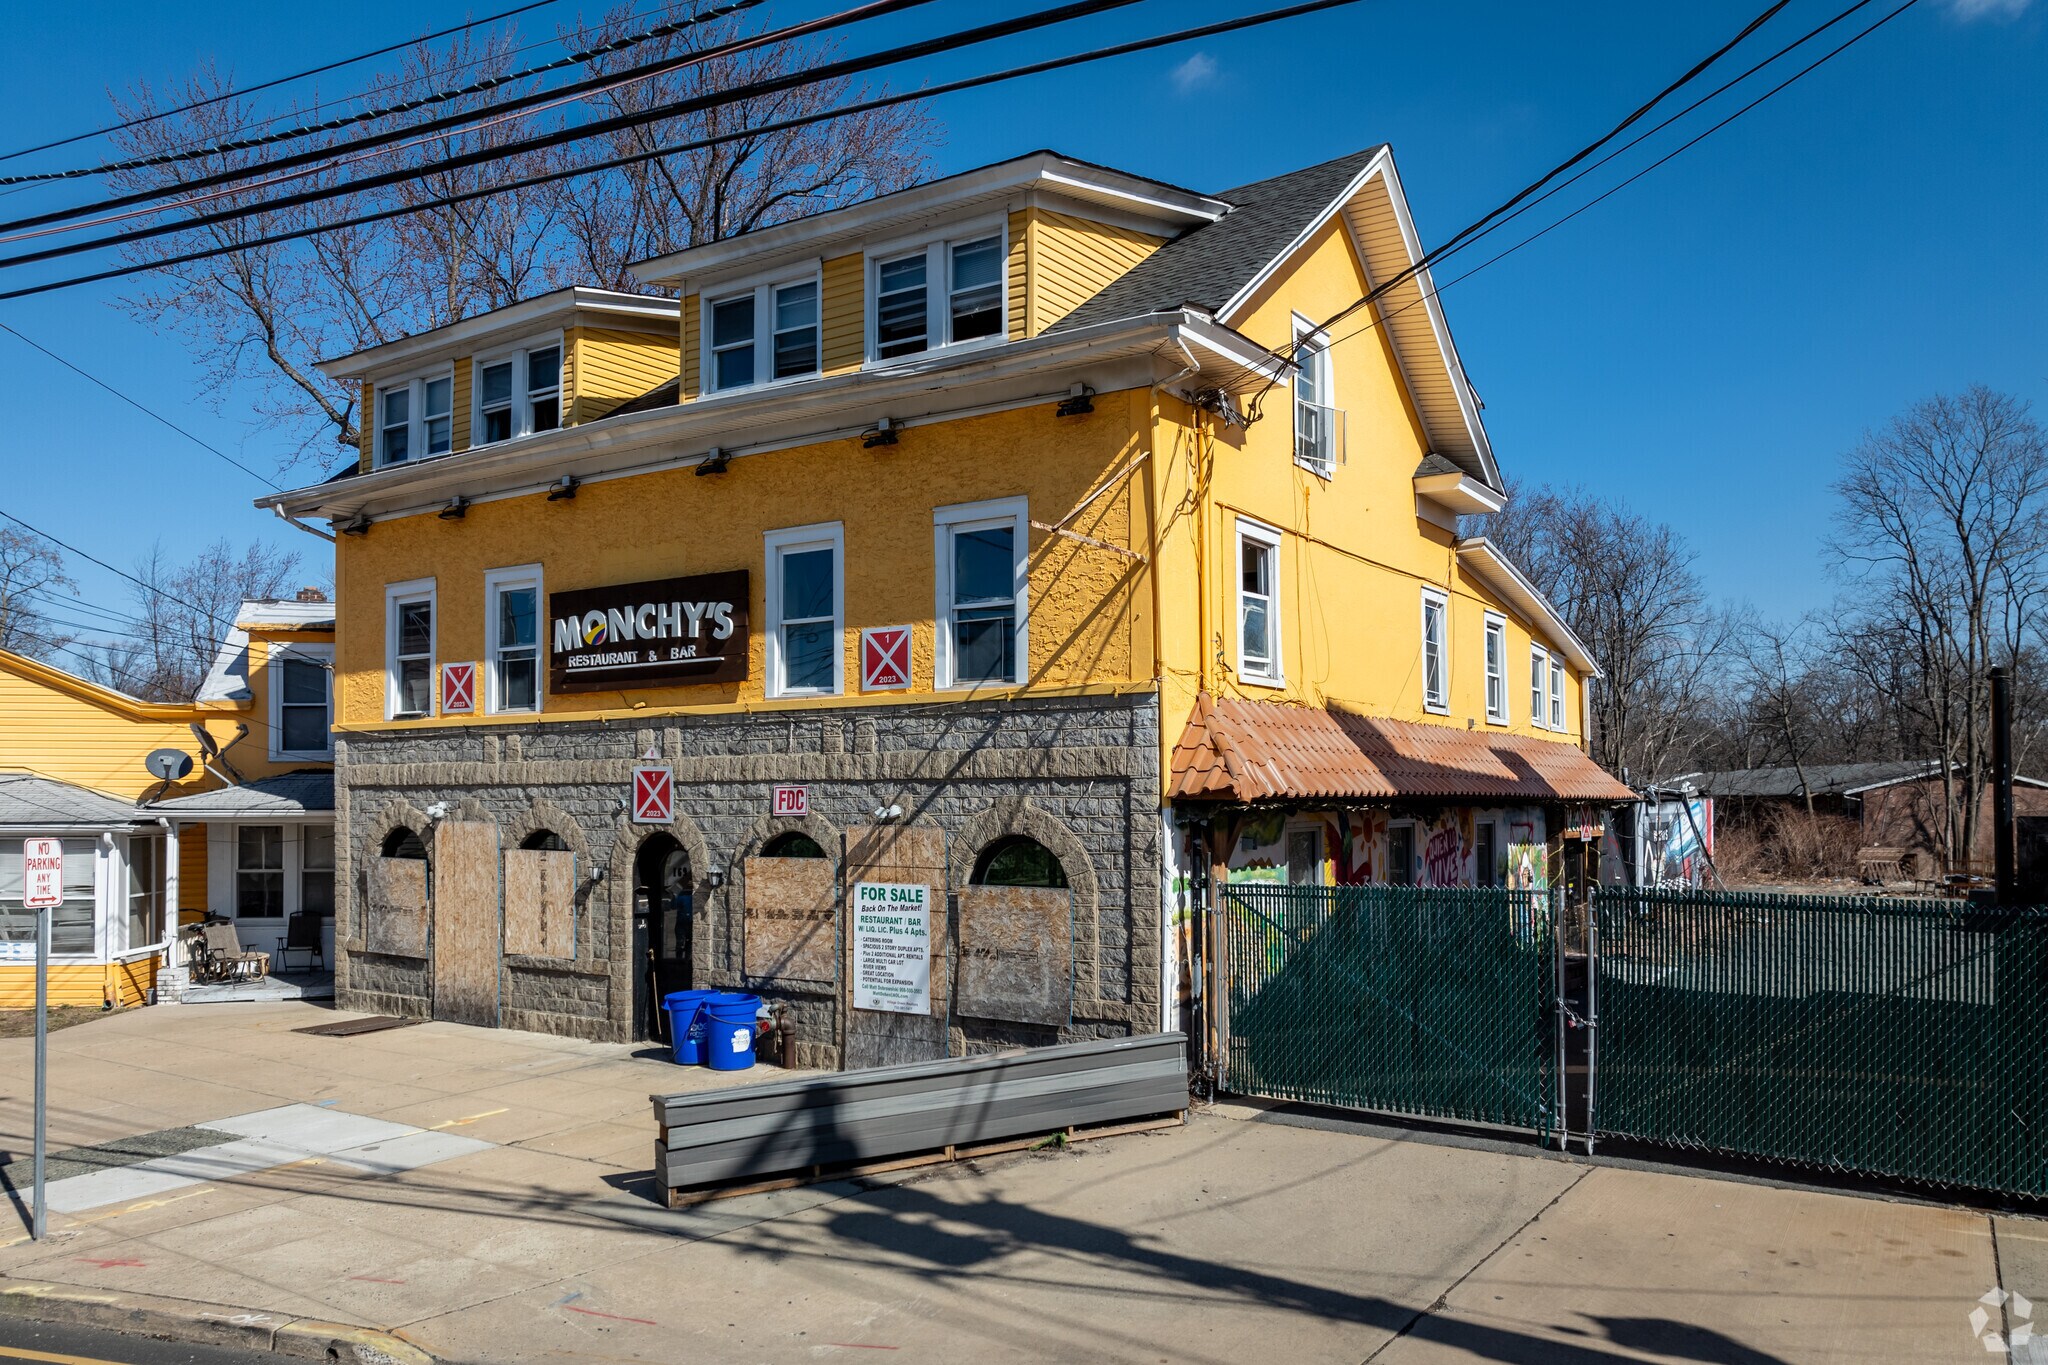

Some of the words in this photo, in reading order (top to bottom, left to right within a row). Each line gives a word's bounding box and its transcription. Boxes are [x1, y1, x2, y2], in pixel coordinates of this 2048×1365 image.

[554, 602, 734, 653] MONCHY'S
[885, 634, 890, 643] 1
[568, 651, 638, 668] RESTAURANT
[648, 650, 658, 662] &
[670, 645, 696, 660] BAR
[879, 675, 897, 684] 2023
[651, 773, 656, 781] 1
[778, 789, 804, 810] FDC
[38, 842, 50, 855] NO
[27, 857, 60, 871] PARKING
[1430, 852, 1457, 886] VIVE
[37, 873, 51, 883] ANY
[36, 885, 51, 895] TIME
[861, 886, 886, 901] FOR
[890, 888, 923, 903] SALE
[861, 904, 876, 912] Back
[877, 904, 886, 912] On
[887, 904, 898, 912] The
[899, 904, 923, 912] Market!
[860, 915, 903, 925] RESTAURANT
[908, 918, 921, 926] BAR
[878, 926, 888, 934] LIC.
[889, 926, 903, 935] Plus
[910, 928, 927, 937] Apts.
[891, 978, 914, 986] EXPANSION
